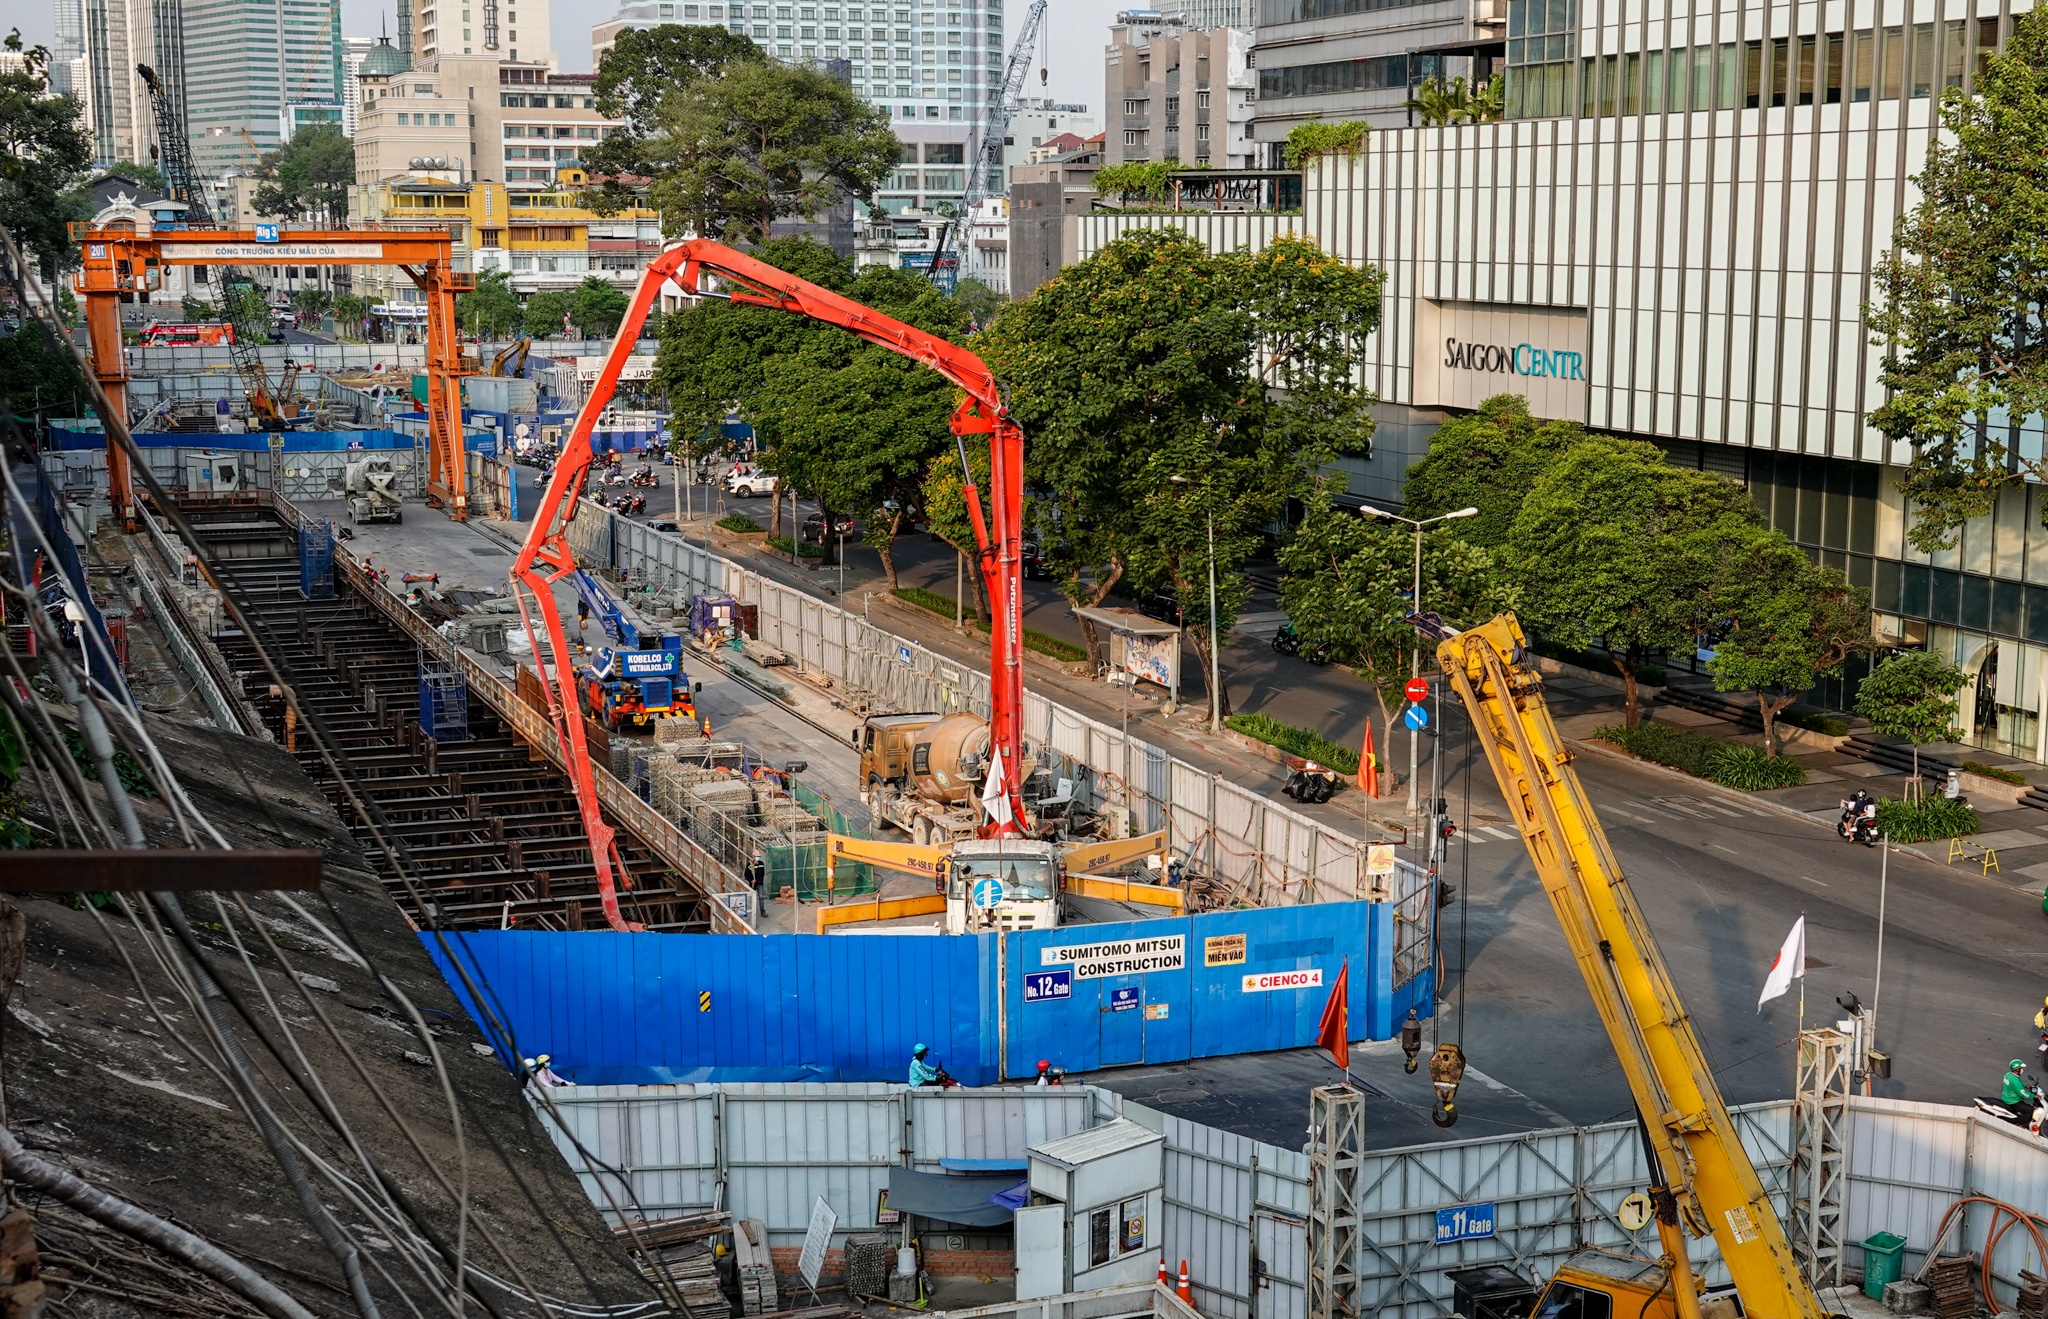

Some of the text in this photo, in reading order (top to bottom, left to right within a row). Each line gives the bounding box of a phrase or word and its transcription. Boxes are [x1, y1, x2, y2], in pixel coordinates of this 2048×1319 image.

[257, 226, 277, 239] Rig 3
[91, 244, 105, 257] 20T
[215, 246, 239, 255] CÔNG
[1010, 576, 1018, 645] Putzmeister
[627, 653, 662, 664] KOBELCO
[1060, 938, 1181, 961] SUMITOMO MITSUI
[1228, 949, 1244, 961] VÀO
[1078, 955, 1182, 977] CONSTRUCTION
[1259, 972, 1319, 988] CIENCO 4
[1053, 984, 1069, 995] Gate
[1468, 1219, 1492, 1234] Gate
